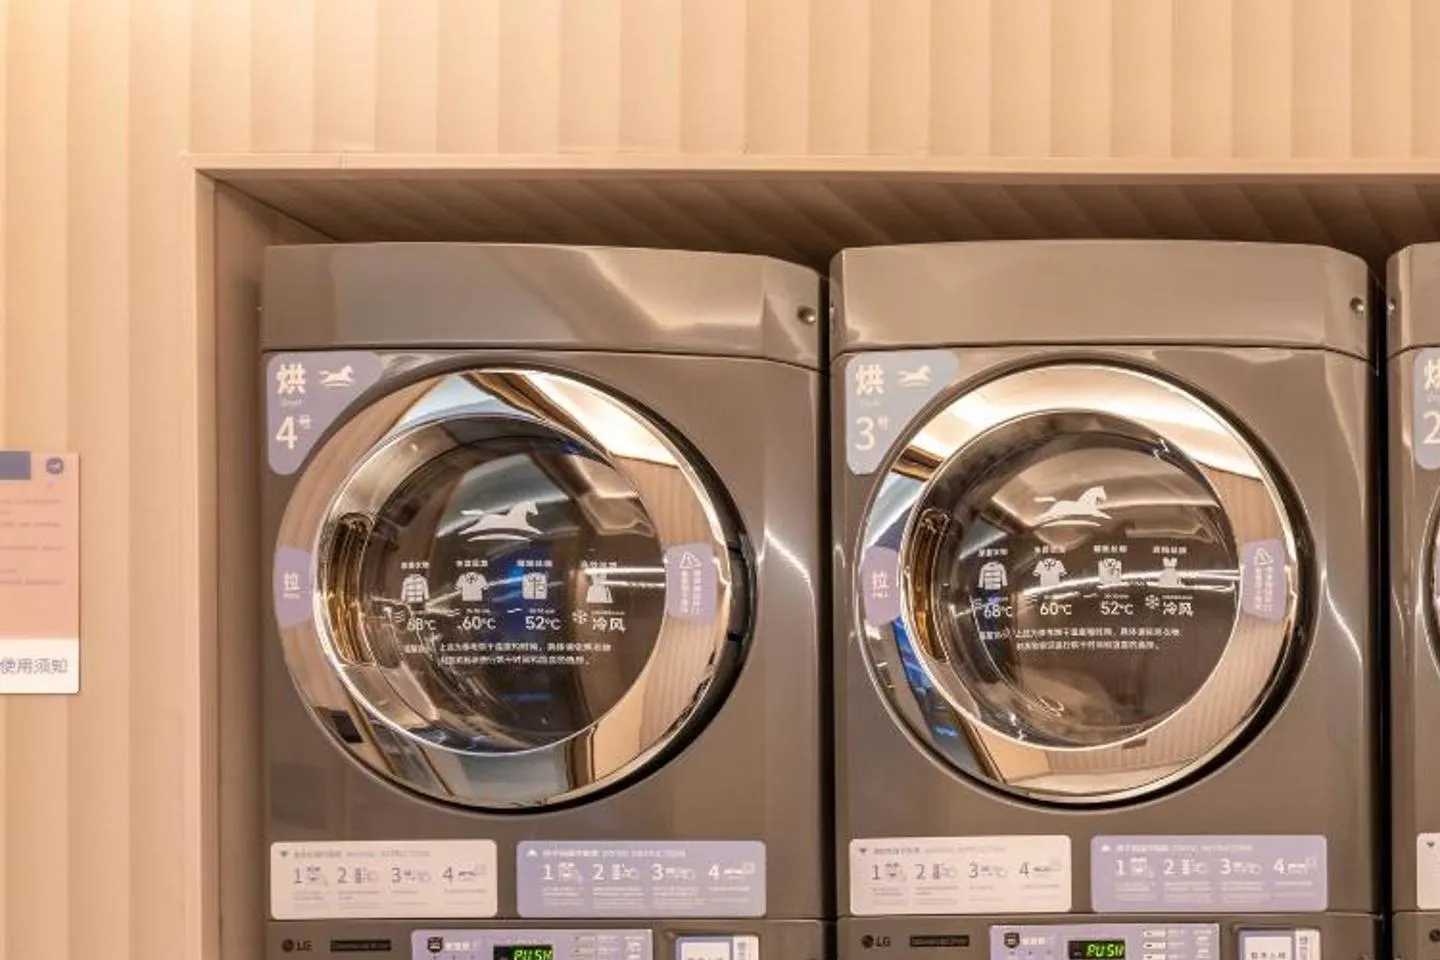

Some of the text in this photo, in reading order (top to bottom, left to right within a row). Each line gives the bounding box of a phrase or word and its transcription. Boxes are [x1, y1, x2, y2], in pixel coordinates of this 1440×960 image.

[276, 363, 306, 396] 烘
[855, 365, 884, 394] 烘
[294, 866, 453, 884] 1 2 3 4
[544, 863, 720, 880] 1 2 3 4
[872, 862, 1030, 880] 1 2 3 4
[1116, 858, 1285, 876] 1 2 3 4
[1087, 944, 1124, 957] PUSH
